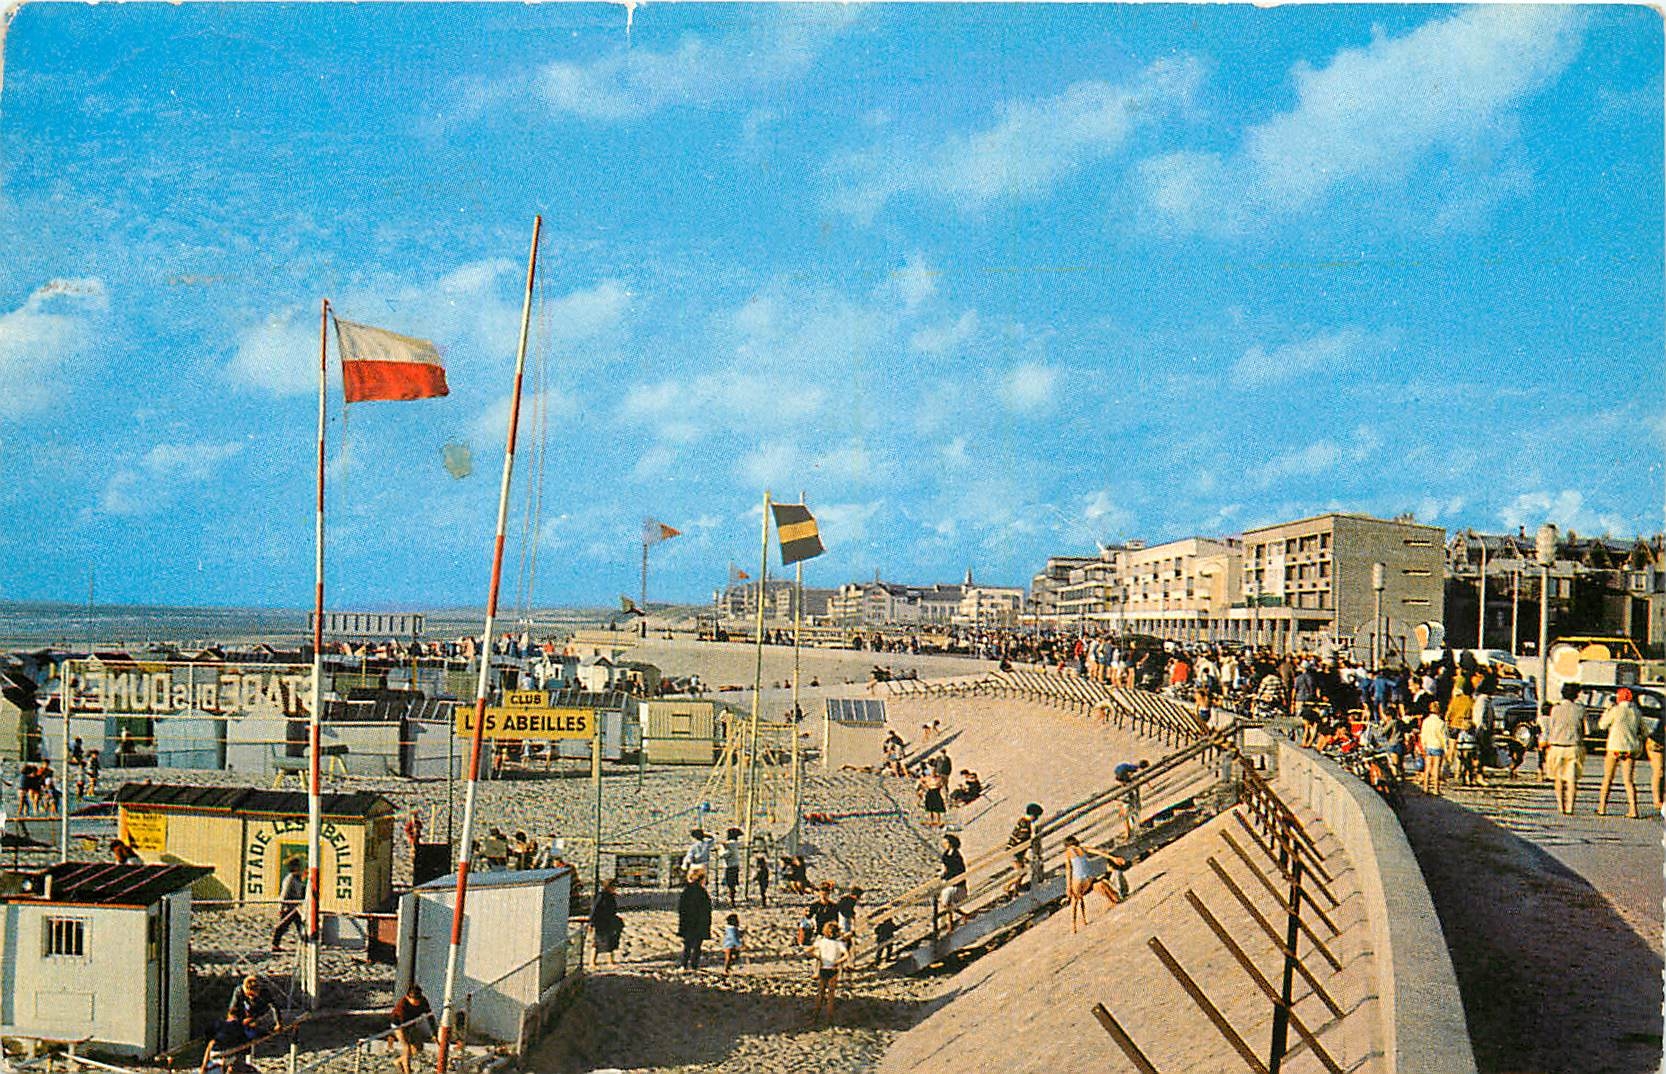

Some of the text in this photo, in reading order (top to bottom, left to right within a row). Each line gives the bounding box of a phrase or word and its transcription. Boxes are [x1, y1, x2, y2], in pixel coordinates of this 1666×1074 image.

[510, 694, 542, 705] CLUB
[465, 714, 587, 732] LS ABEILLES
[247, 830, 272, 894] STADE
[320, 823, 352, 899] BEILLES
